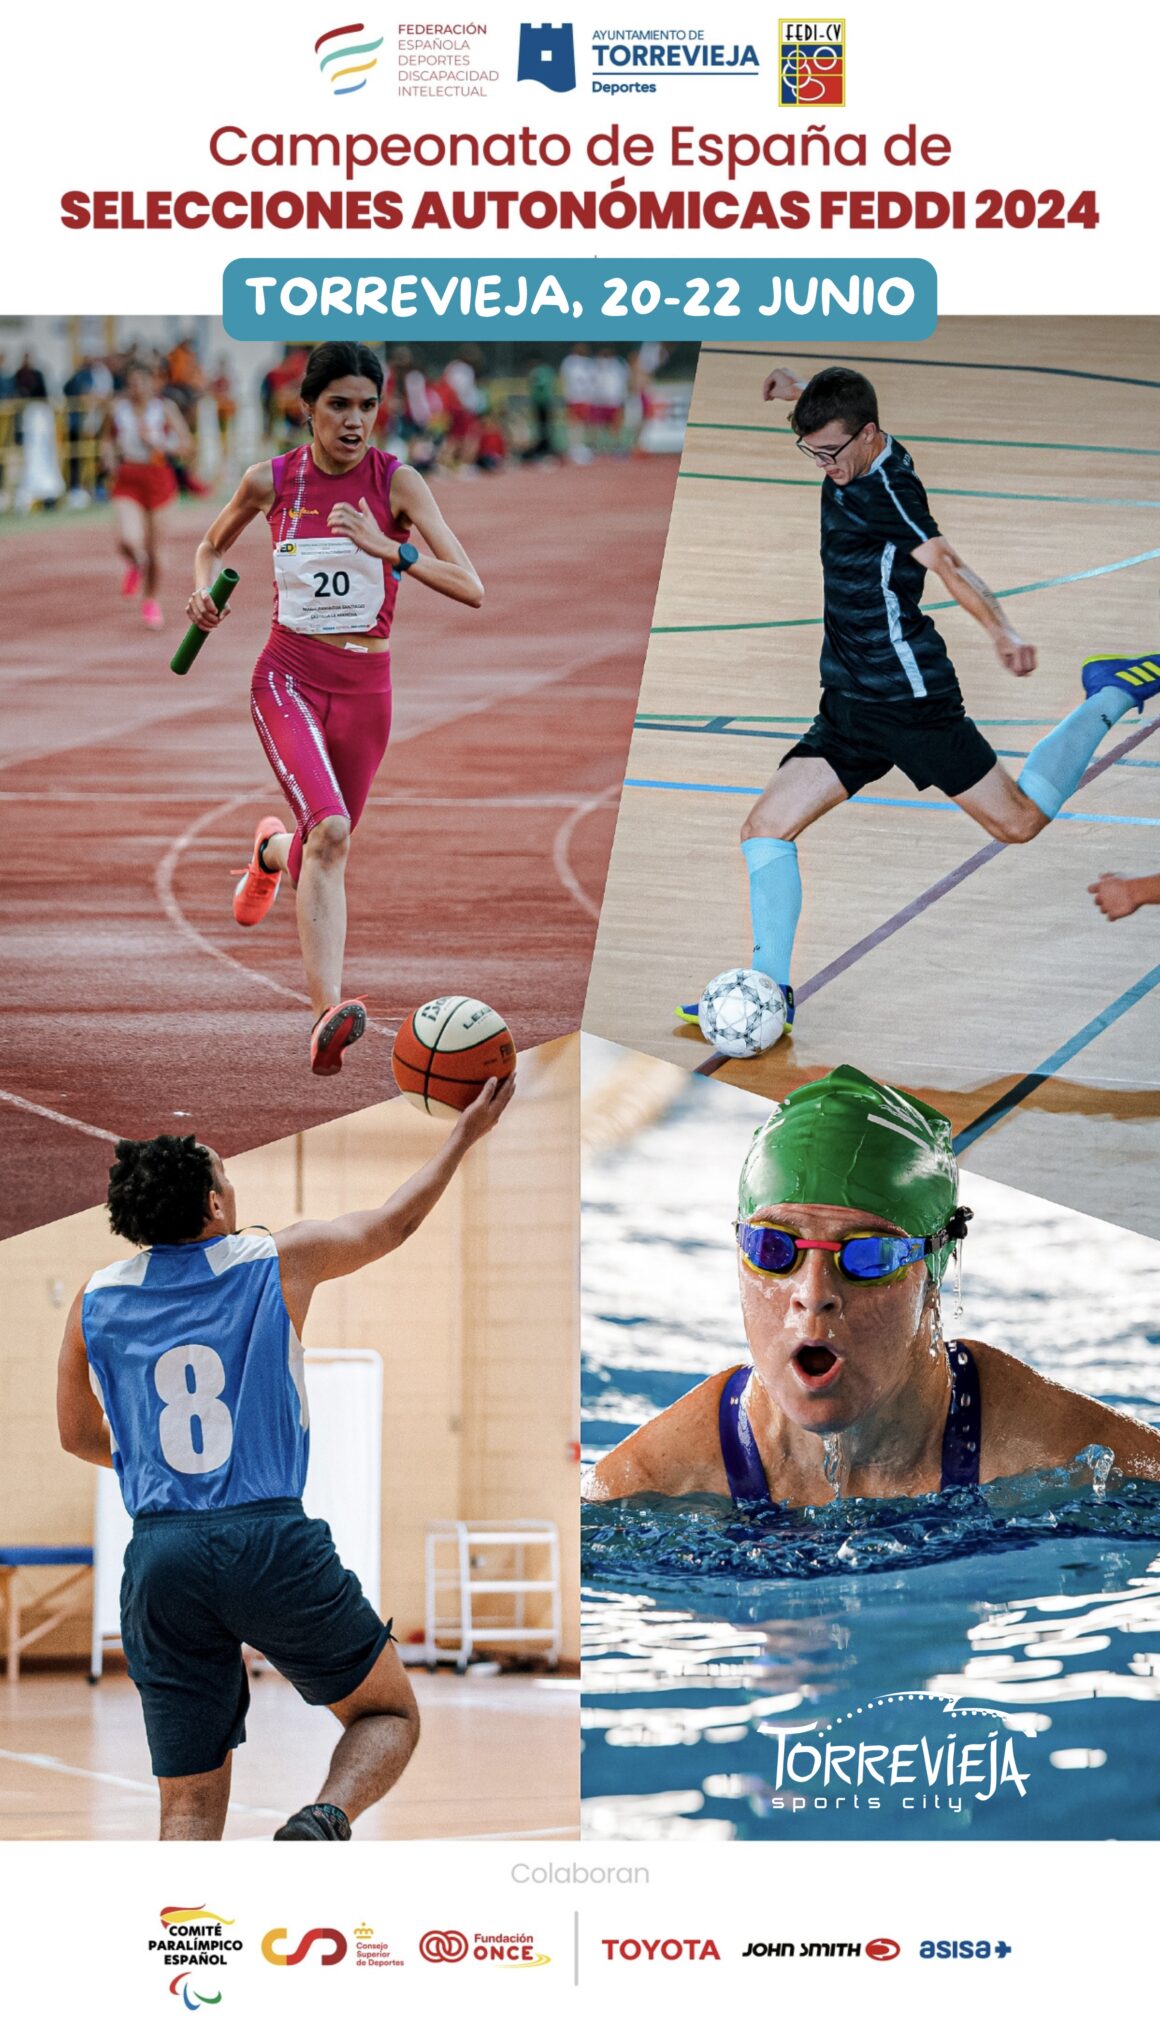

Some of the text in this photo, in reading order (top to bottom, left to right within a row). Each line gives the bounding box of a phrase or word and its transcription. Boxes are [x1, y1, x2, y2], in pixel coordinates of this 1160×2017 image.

[398, 22, 487, 35] FEDERACIÓN
[592, 30, 704, 41] AYUNTAMIENTO DE
[786, 24, 841, 41] FEDI-CV
[398, 38, 470, 51] ESPAÑOLA
[398, 55, 470, 66] DEPORTES
[592, 44, 760, 67] TORREVIEJA
[398, 70, 499, 82] DISCAPACIDAD
[398, 86, 487, 97] INTELECTUAL
[592, 81, 657, 96] Deportes
[209, 123, 951, 181] Campeonato de España de
[60, 176, 1100, 230] SELECCIONES AUTONÓMICAS FEDDI 2024
[246, 276, 914, 318] TORREVIEJA, 20-22 JUNIO
[313, 571, 350, 598] 20
[154, 1344, 233, 1474] 8
[757, 1721, 1031, 1801] TORREVIEJA
[772, 1794, 962, 1813] sports city
[511, 1862, 649, 1884] Colaboran
[168, 1922, 222, 1937] COMITÉ
[148, 1936, 243, 1951] PARALÍMPICO
[473, 1932, 534, 1944] Fundación
[356, 1942, 388, 1951] Consejo
[473, 1945, 534, 1961] ONCE
[601, 1938, 721, 1961] TOYOTA
[741, 1942, 862, 1958] JOHN SMITH
[919, 1940, 991, 1959] asisa
[163, 1951, 228, 1966] ESPAÑOL
[356, 1950, 391, 1960] Superior
[356, 1958, 405, 1969] de Deportes
